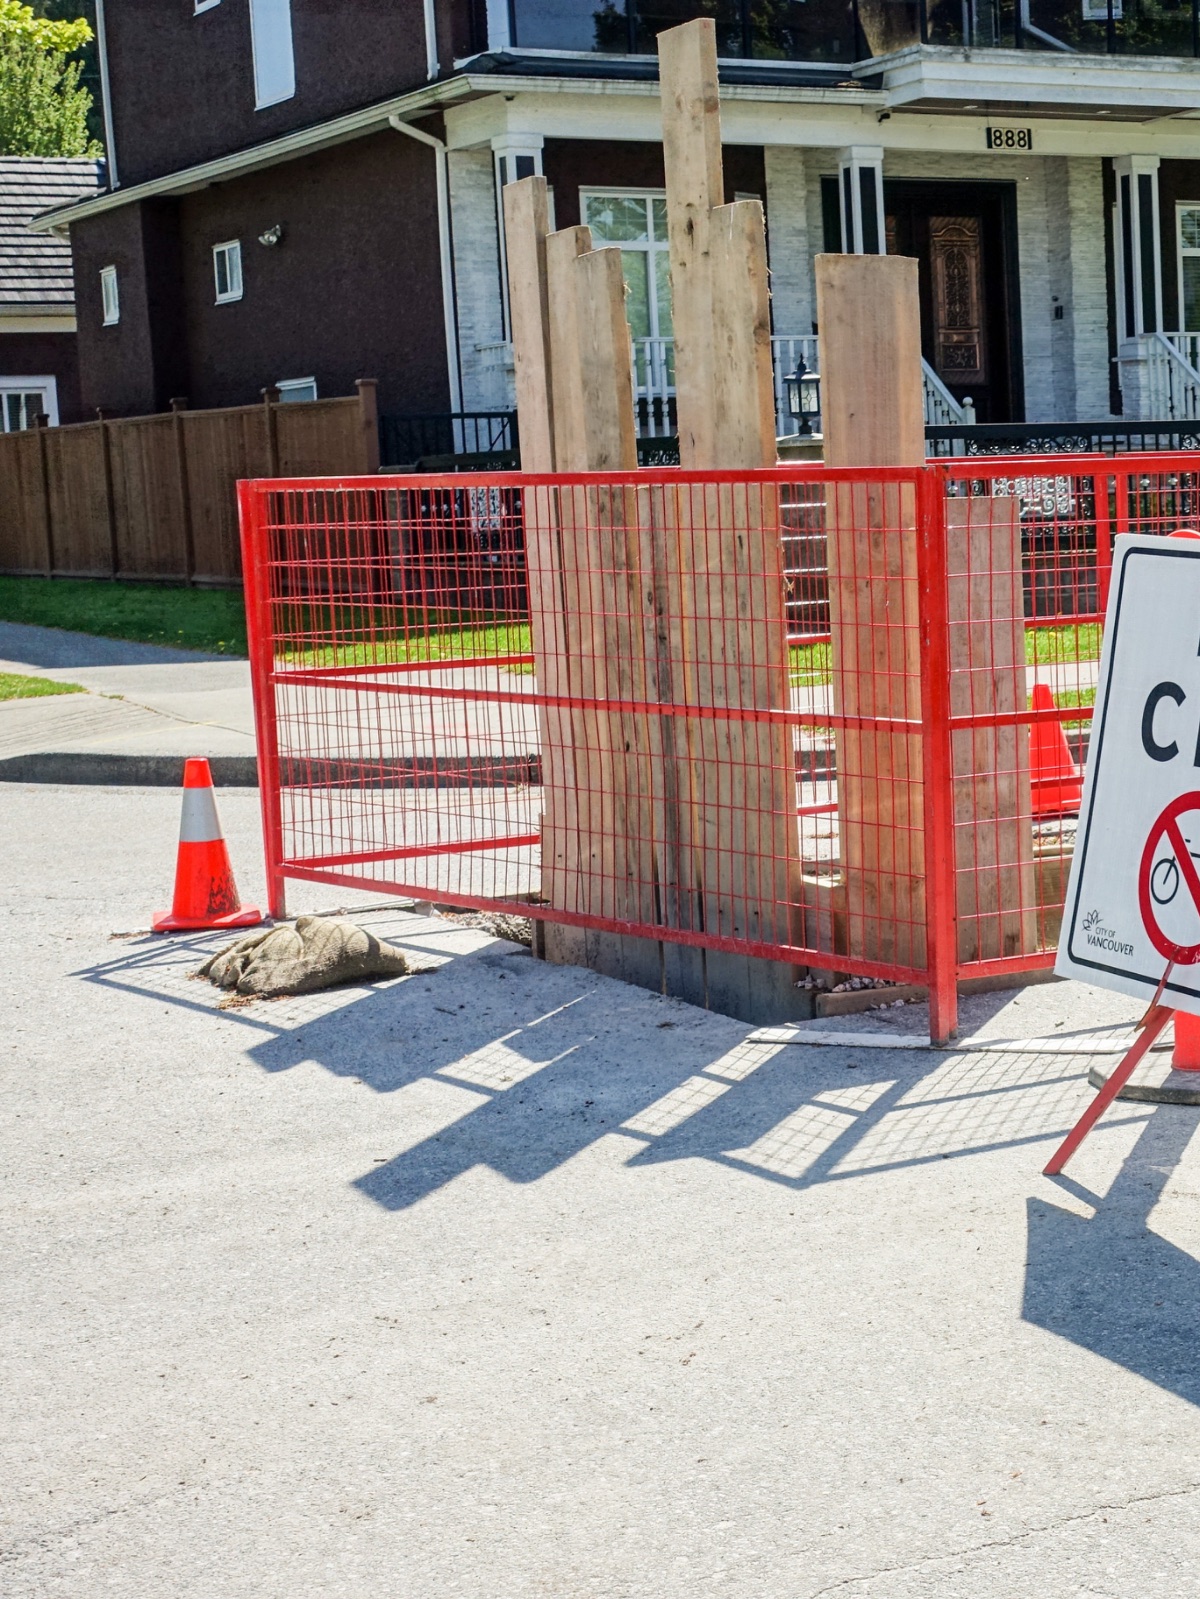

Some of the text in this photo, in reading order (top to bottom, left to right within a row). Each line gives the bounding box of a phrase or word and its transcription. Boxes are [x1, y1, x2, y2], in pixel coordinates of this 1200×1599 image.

[993, 129, 1027, 148] 888
[1095, 926, 1116, 938] CITY OF
[1087, 934, 1134, 956] VANCOUVER
